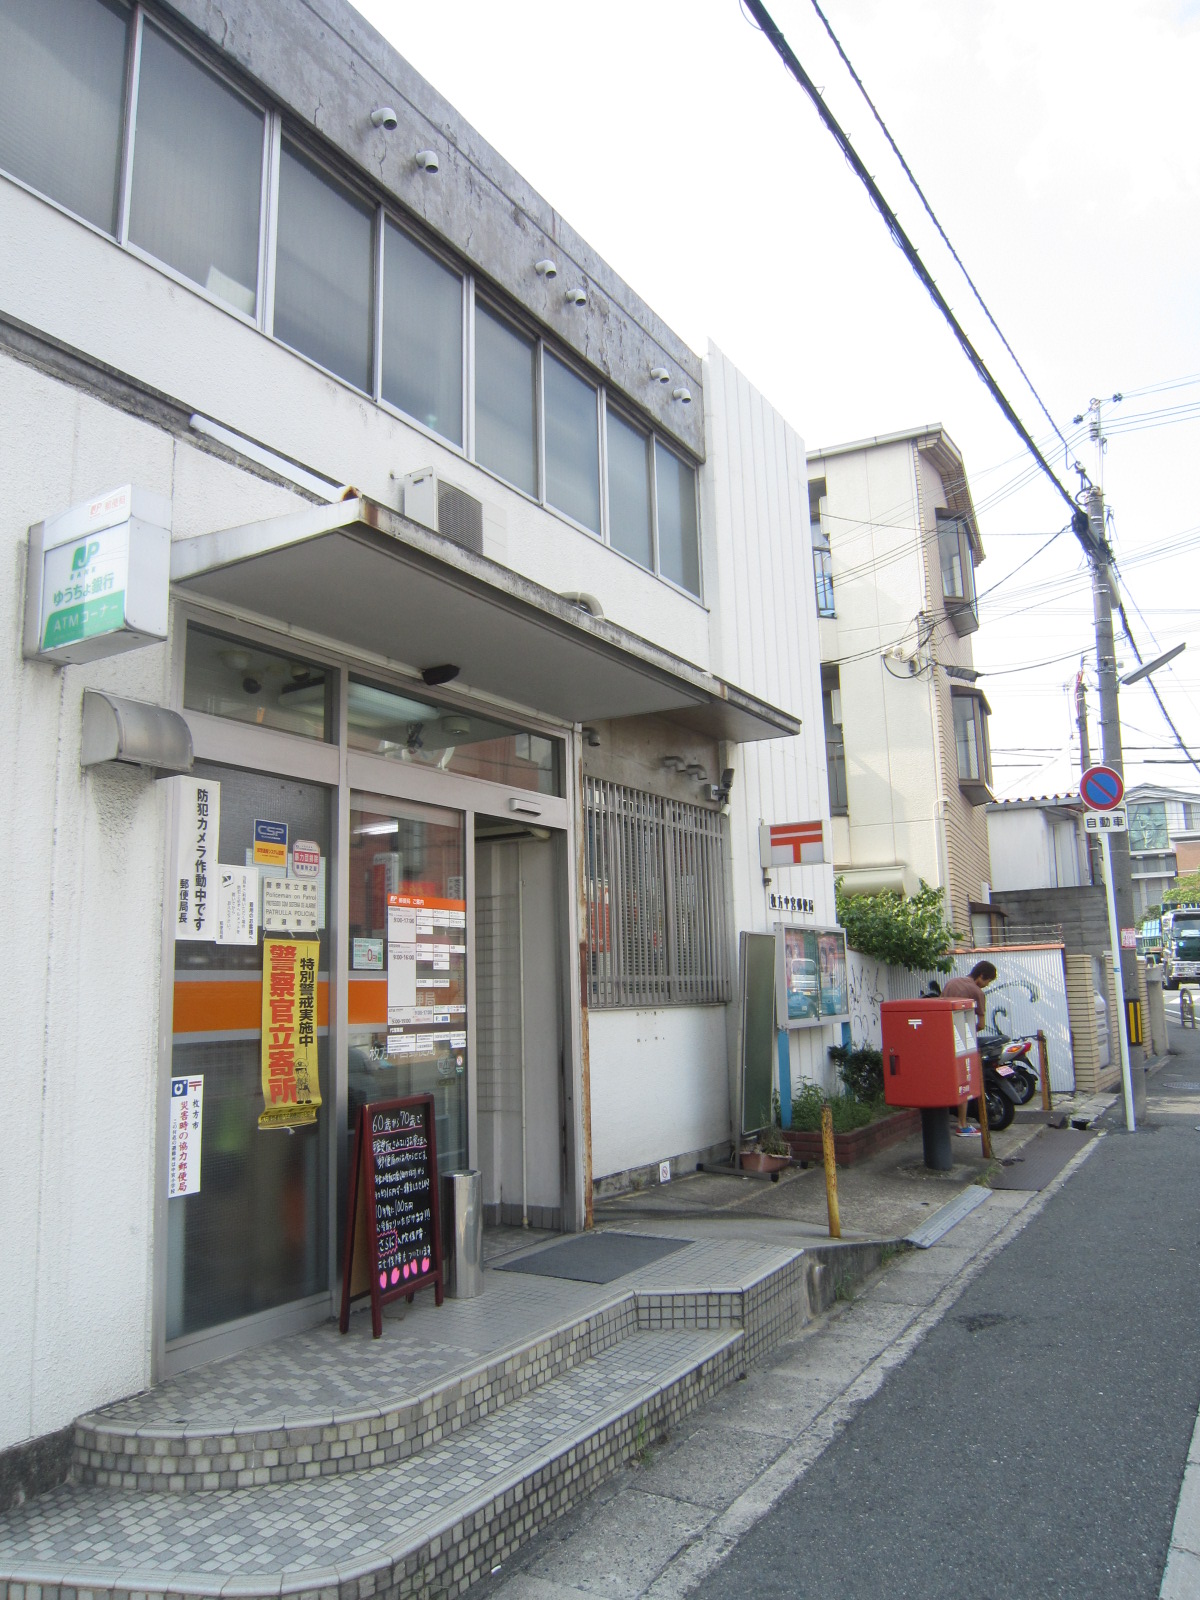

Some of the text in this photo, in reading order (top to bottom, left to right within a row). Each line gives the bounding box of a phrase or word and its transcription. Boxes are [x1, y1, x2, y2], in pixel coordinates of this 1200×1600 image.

[72, 541, 100, 571] JP
[53, 572, 114, 607] ゆうちょ銀行
[53, 603, 118, 633] ATM コーナー
[257, 825, 284, 837] CSP
[1086, 816, 1124, 829] 自動車
[193, 788, 209, 931] 防犯カメラ作動中です
[178, 878, 190, 924] 郵便局長
[265, 891, 292, 899] Policeman
[302, 893, 317, 901] Patrol
[265, 908, 292, 916] PATRULLA
[298, 957, 315, 1048] 特別警戒実施中
[267, 944, 298, 1105] 警察官立寄所
[191, 1098, 200, 1130] 枚方市
[177, 1100, 189, 1193] 災害時の協力郵便局
